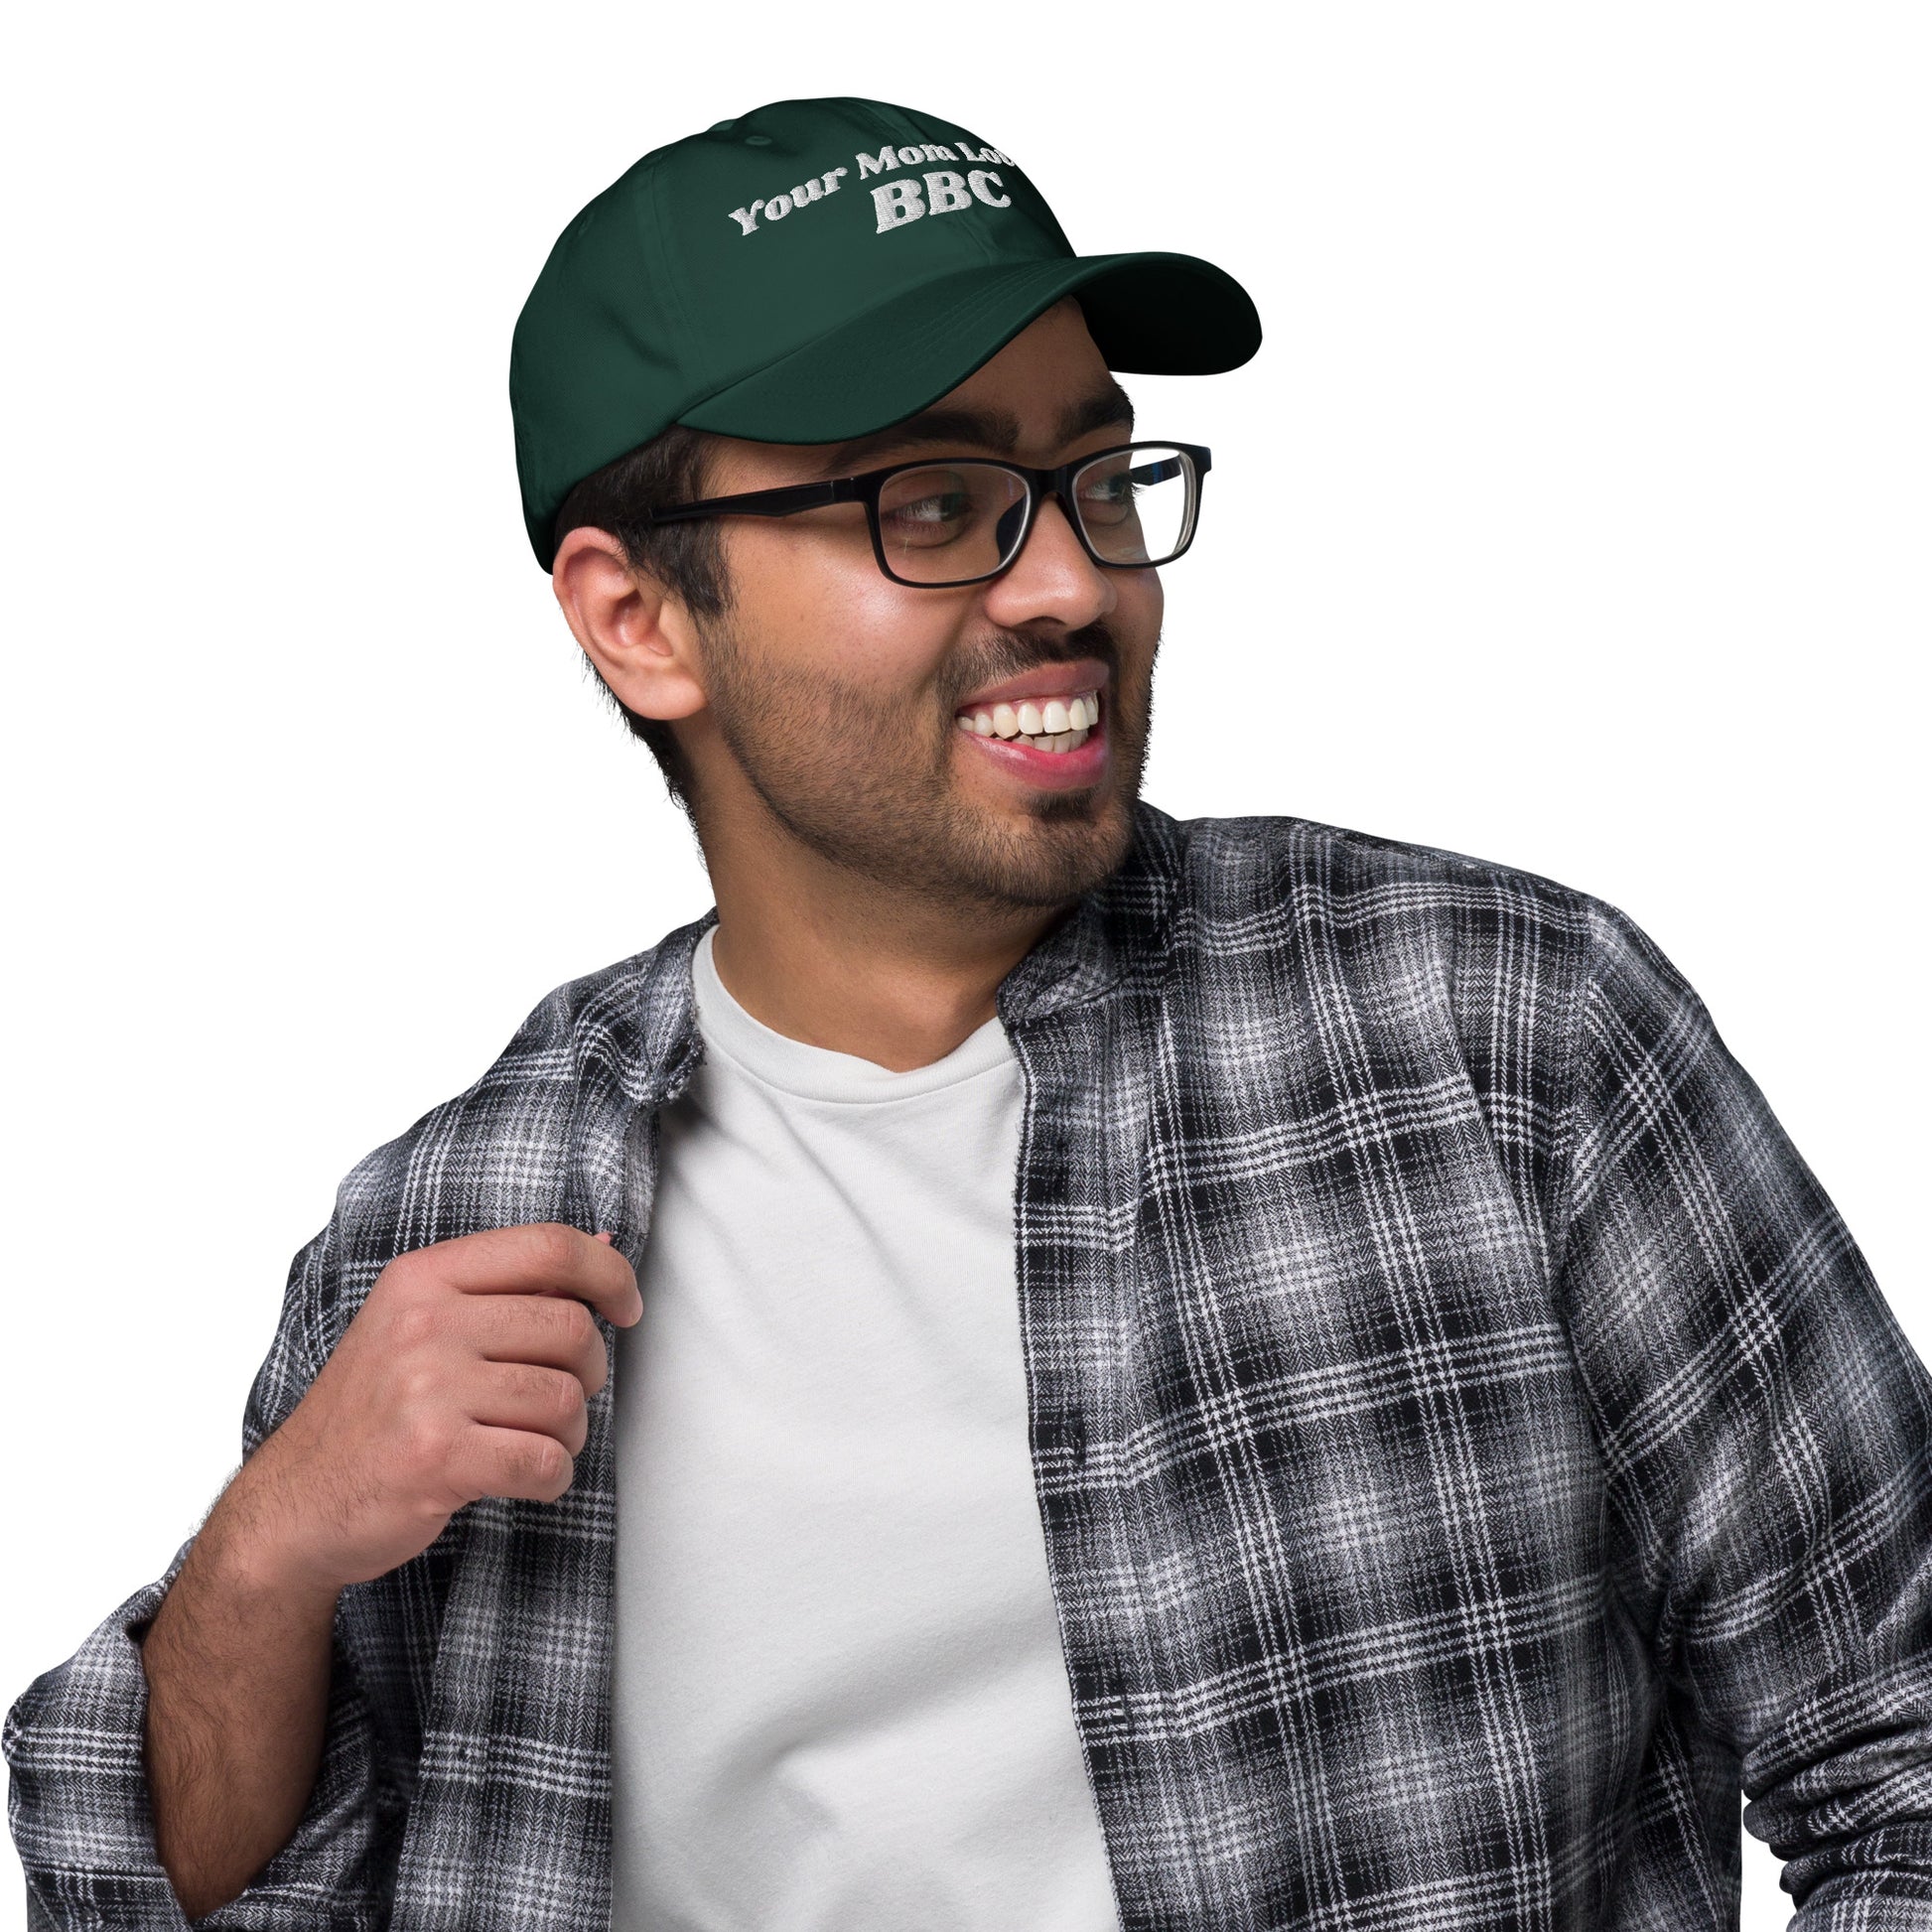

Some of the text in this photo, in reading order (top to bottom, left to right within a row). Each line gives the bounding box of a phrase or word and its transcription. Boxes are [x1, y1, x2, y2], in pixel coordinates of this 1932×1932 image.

[728, 167, 848, 235] Your
[855, 145, 960, 180] Mom
[870, 170, 1012, 234] BBC
